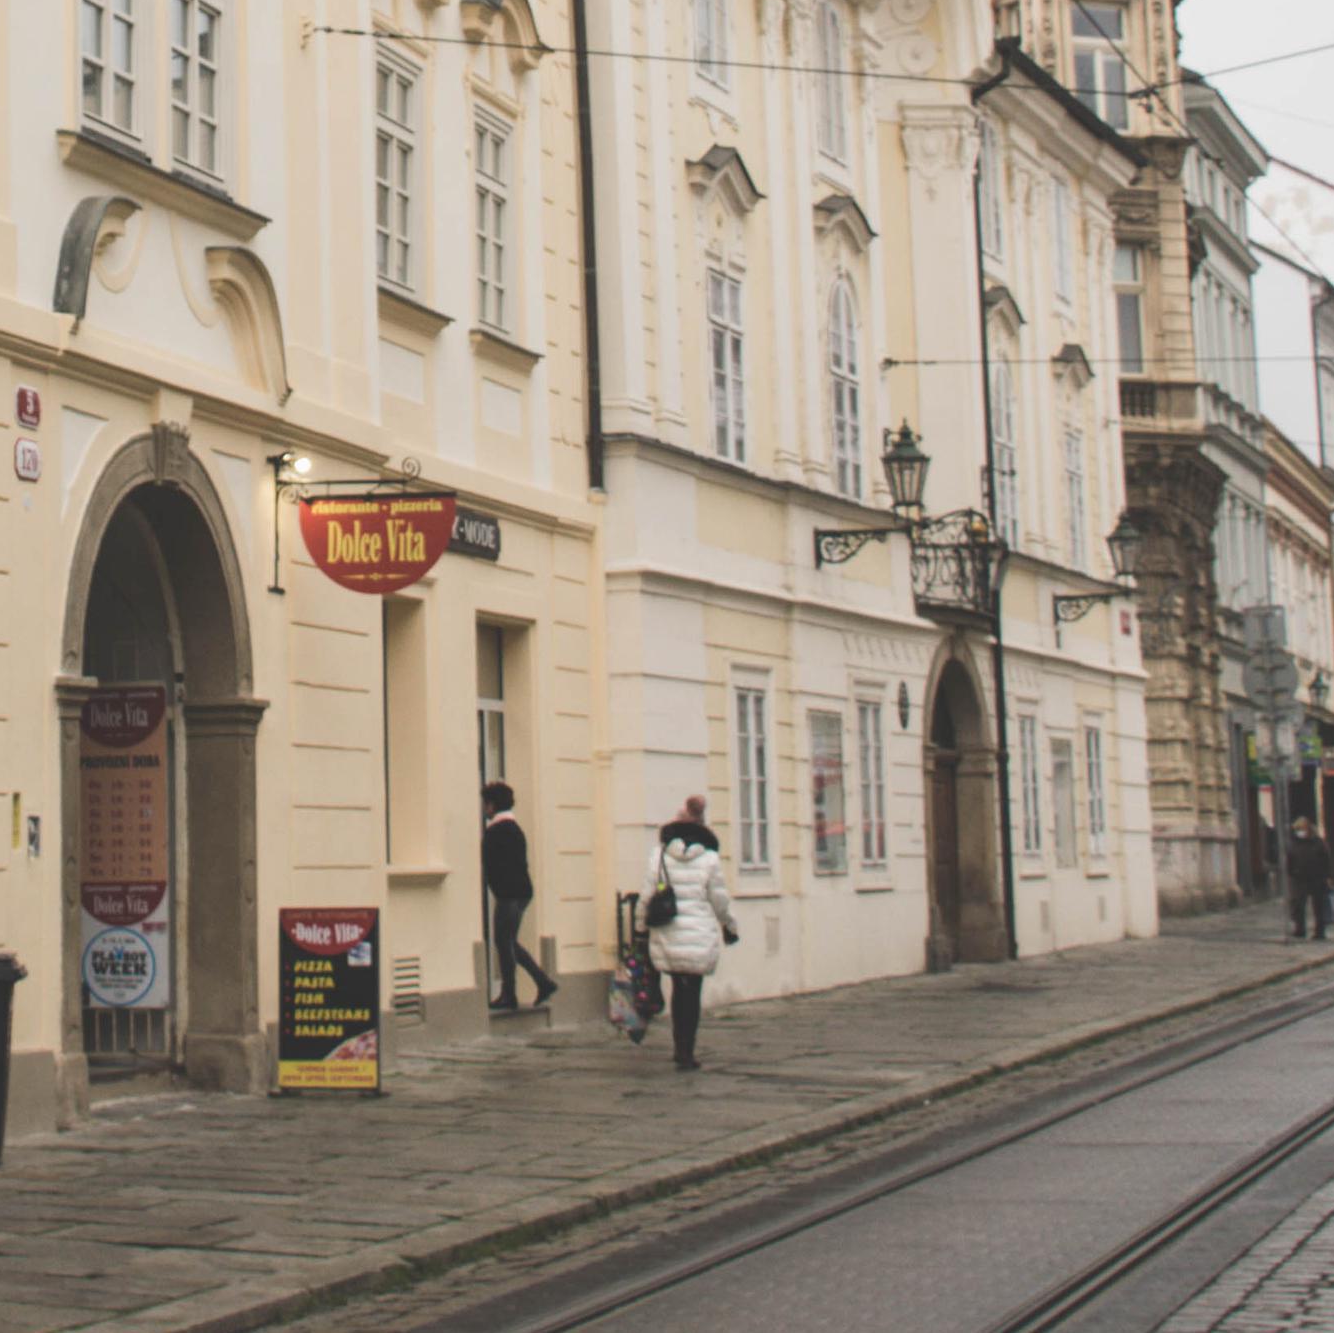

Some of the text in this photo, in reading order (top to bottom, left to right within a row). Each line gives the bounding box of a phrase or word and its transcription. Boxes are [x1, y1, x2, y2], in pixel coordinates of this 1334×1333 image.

[311, 498, 443, 515] ristorante pizzeria
[327, 518, 426, 564] Dolce Vita
[90, 700, 149, 729] Dolce Vita
[93, 893, 149, 916] Dolce Vita
[295, 922, 360, 945] Dolce Vita
[91, 962, 147, 976] WEEK
[294, 960, 333, 973] PIZZA
[294, 976, 335, 989] PASTA
[294, 992, 324, 1005] FISH
[294, 1008, 370, 1021] BEEFSTEAKS
[294, 1024, 344, 1037] SALADS
